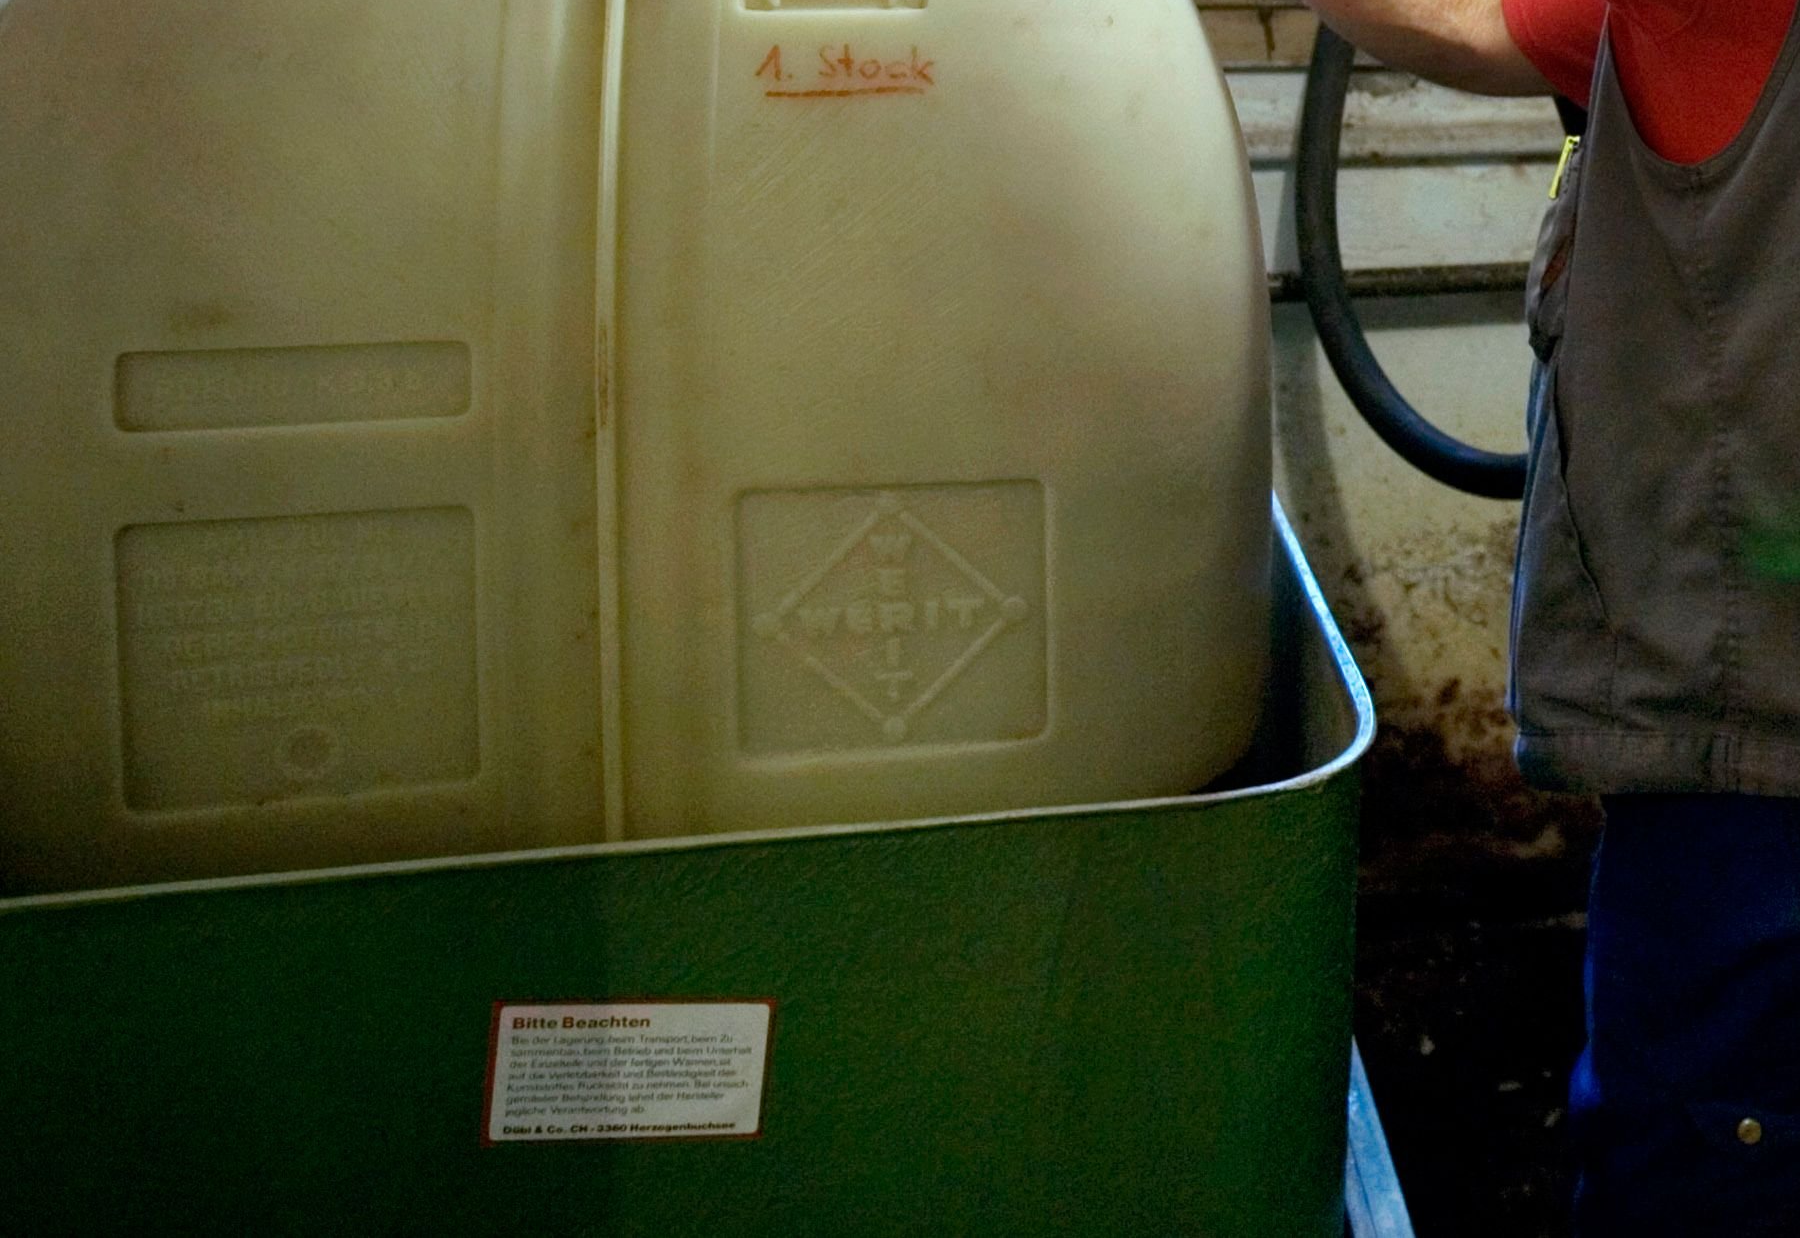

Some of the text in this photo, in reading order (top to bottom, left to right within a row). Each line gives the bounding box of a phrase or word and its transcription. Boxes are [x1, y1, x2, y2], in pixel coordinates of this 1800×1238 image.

[754, 43, 936, 86] 1. Stock
[797, 595, 985, 639] WERIT
[512, 1015, 651, 1030] Bitte Beachten
[535, 1124, 544, 1134] &
[629, 1121, 737, 1133] Herzogenbuchsee
